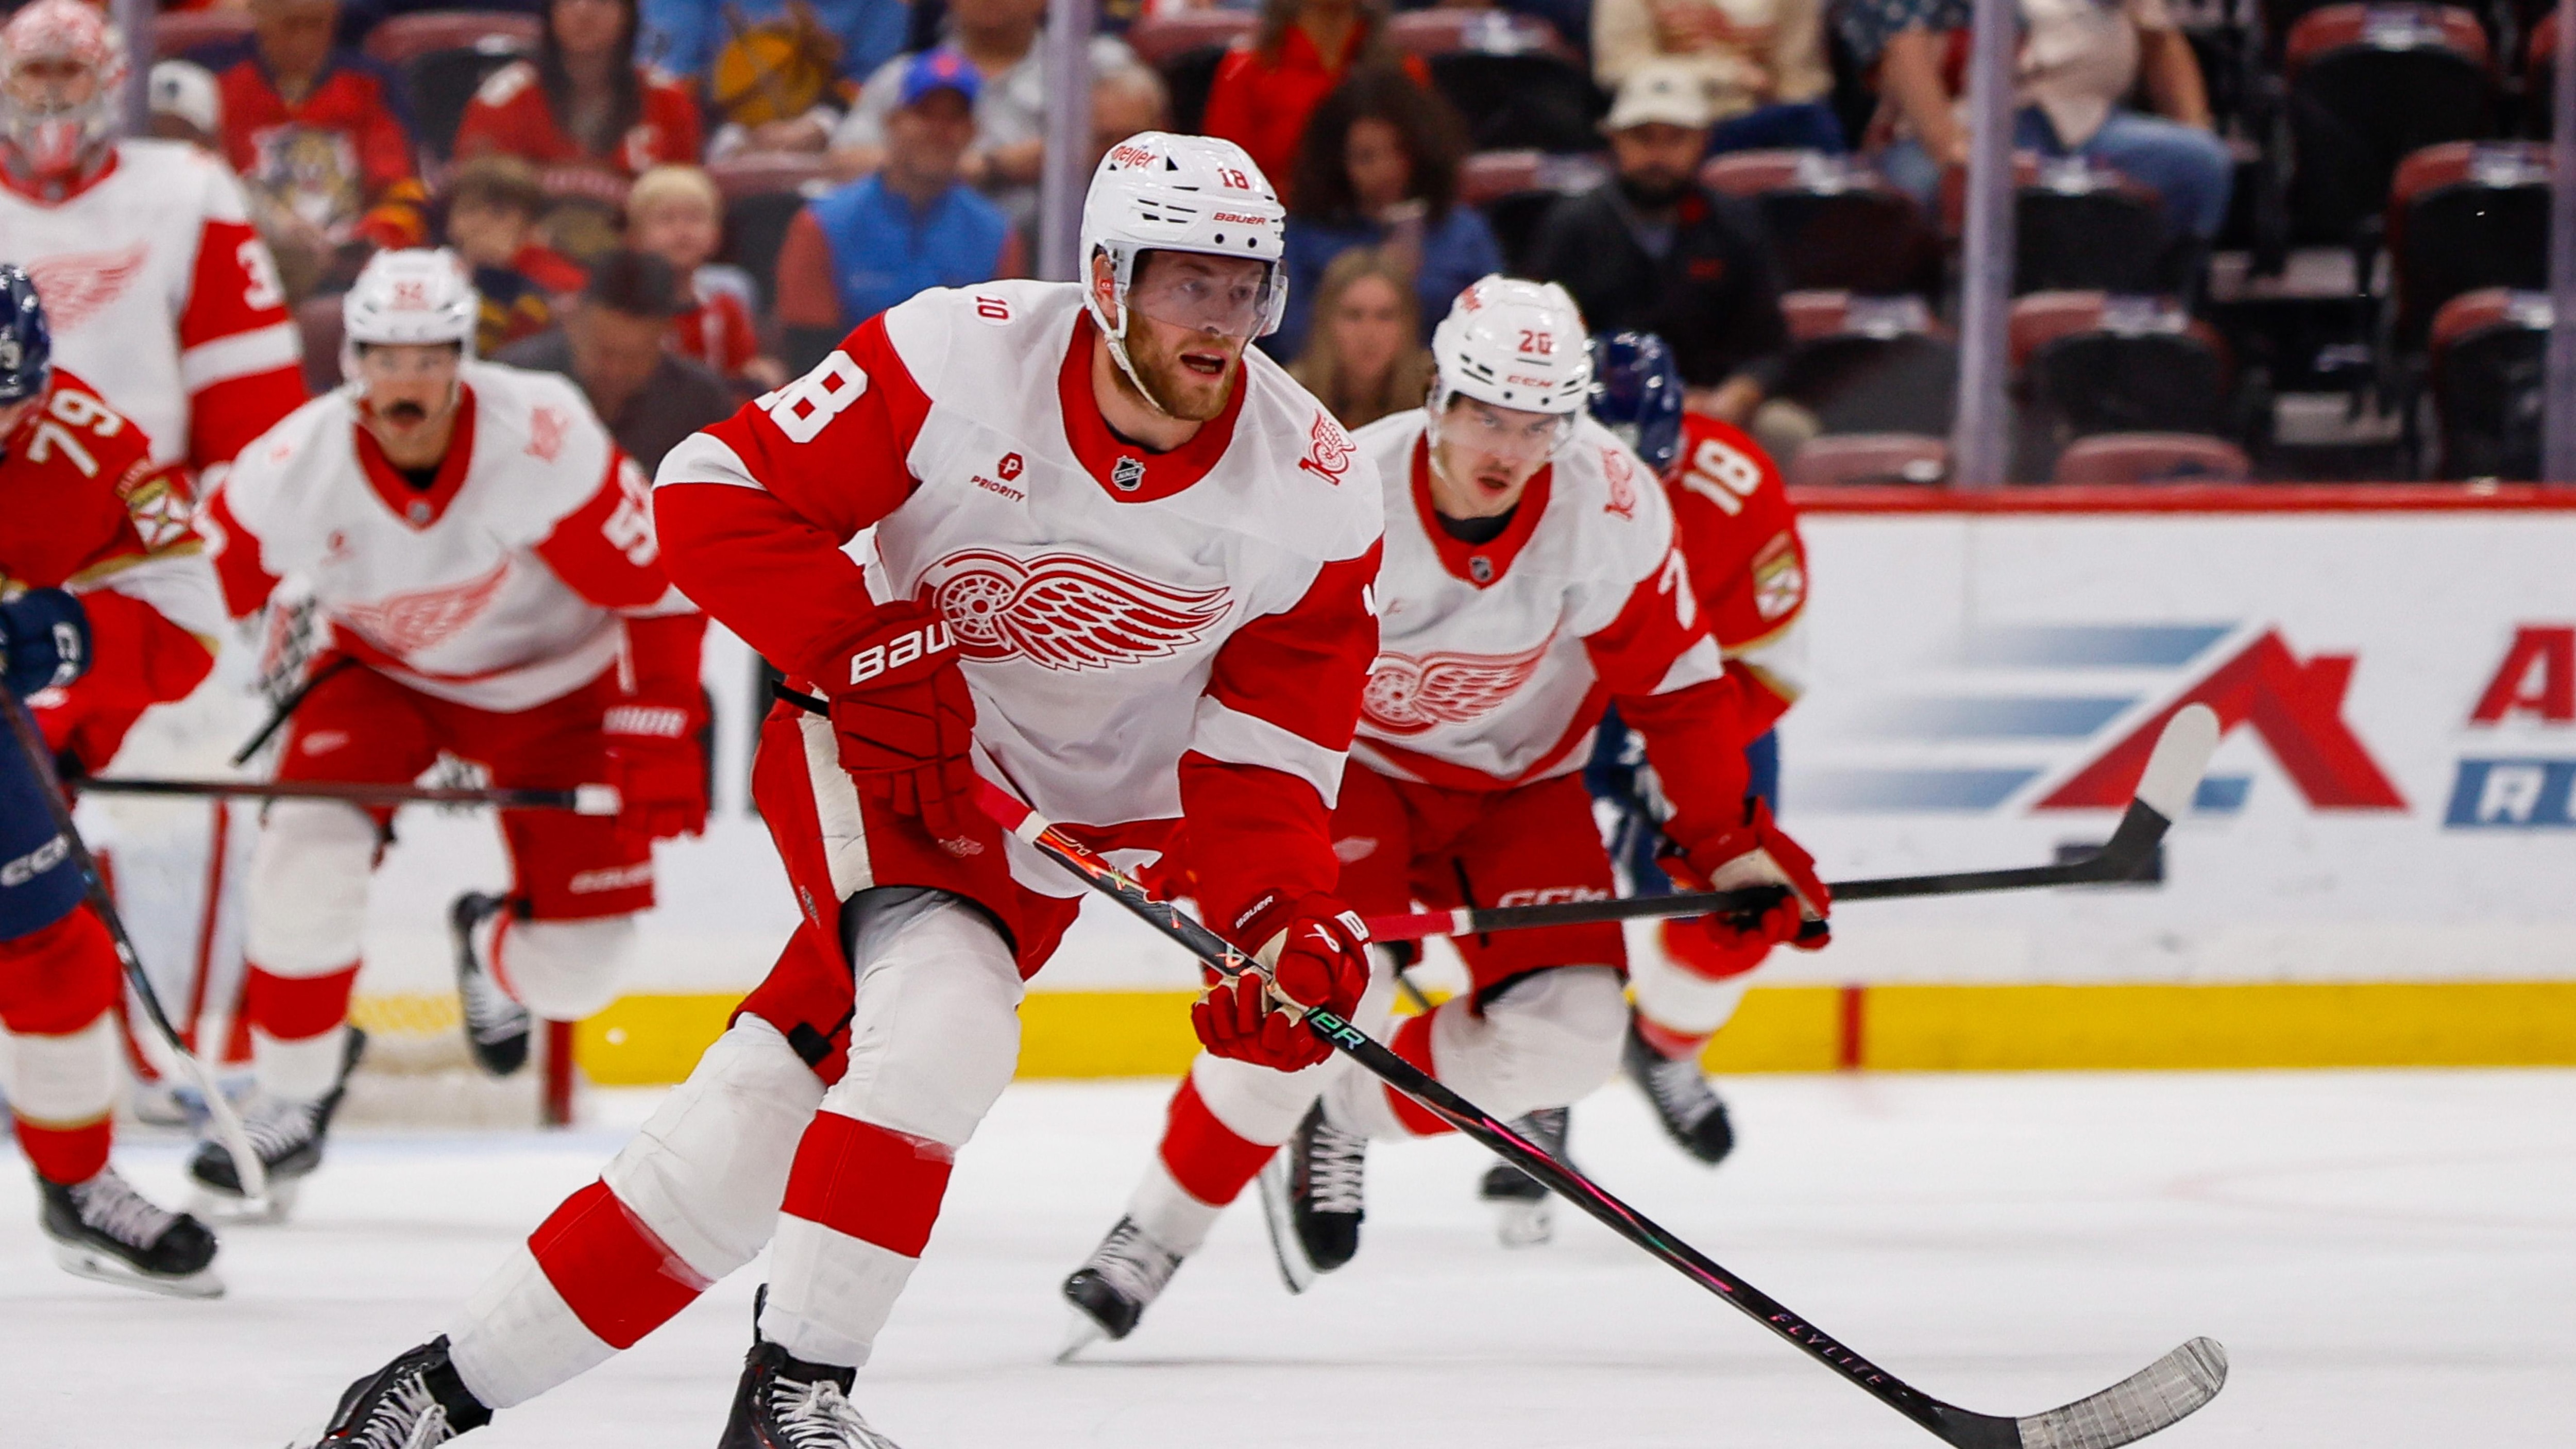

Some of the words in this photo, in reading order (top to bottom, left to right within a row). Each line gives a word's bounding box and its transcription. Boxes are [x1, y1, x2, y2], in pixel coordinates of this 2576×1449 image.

[1217, 168, 1249, 190] 18
[754, 350, 868, 444] 18
[26, 389, 125, 478] 79
[971, 475, 1025, 502] PRIORITY
[1682, 440, 1764, 517] 18
[2475, 767, 2576, 821] R
